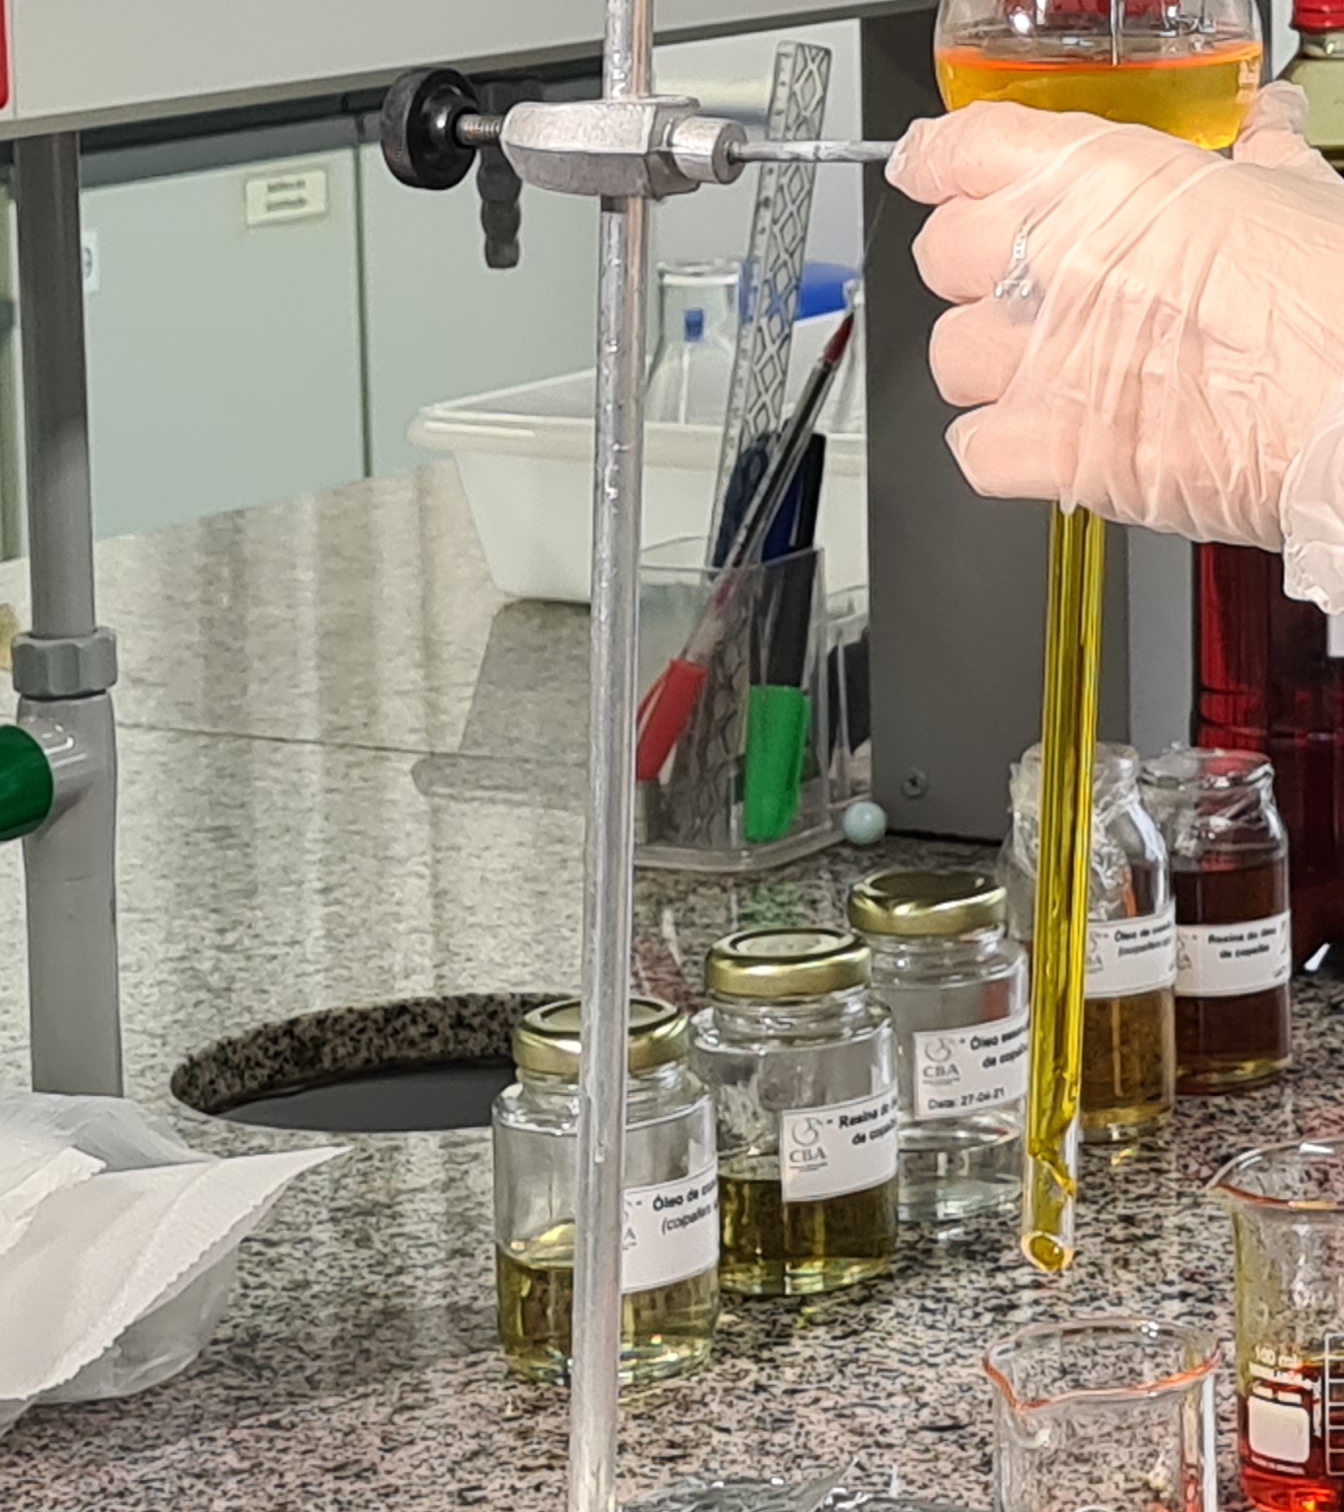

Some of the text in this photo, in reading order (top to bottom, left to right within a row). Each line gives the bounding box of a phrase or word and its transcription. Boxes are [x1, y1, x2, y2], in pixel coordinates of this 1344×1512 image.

[922, 1063, 959, 1078] CBA
[789, 1147, 827, 1163] CBA
[652, 1193, 684, 1212] Óleo
